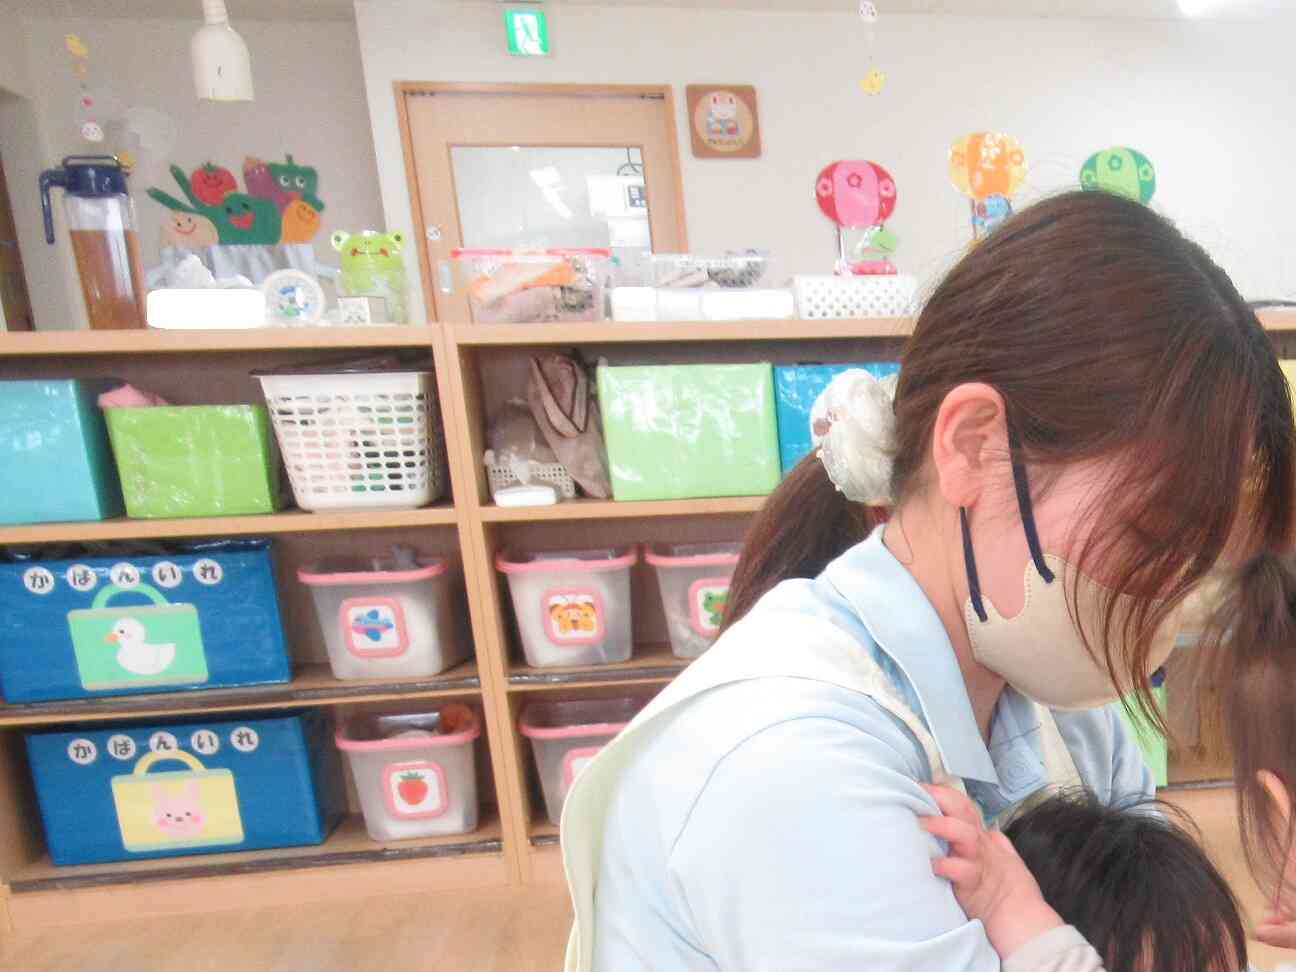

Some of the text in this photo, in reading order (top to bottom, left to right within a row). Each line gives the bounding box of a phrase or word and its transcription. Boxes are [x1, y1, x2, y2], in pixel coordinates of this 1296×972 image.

[73, 730, 255, 759] かばんいれ
